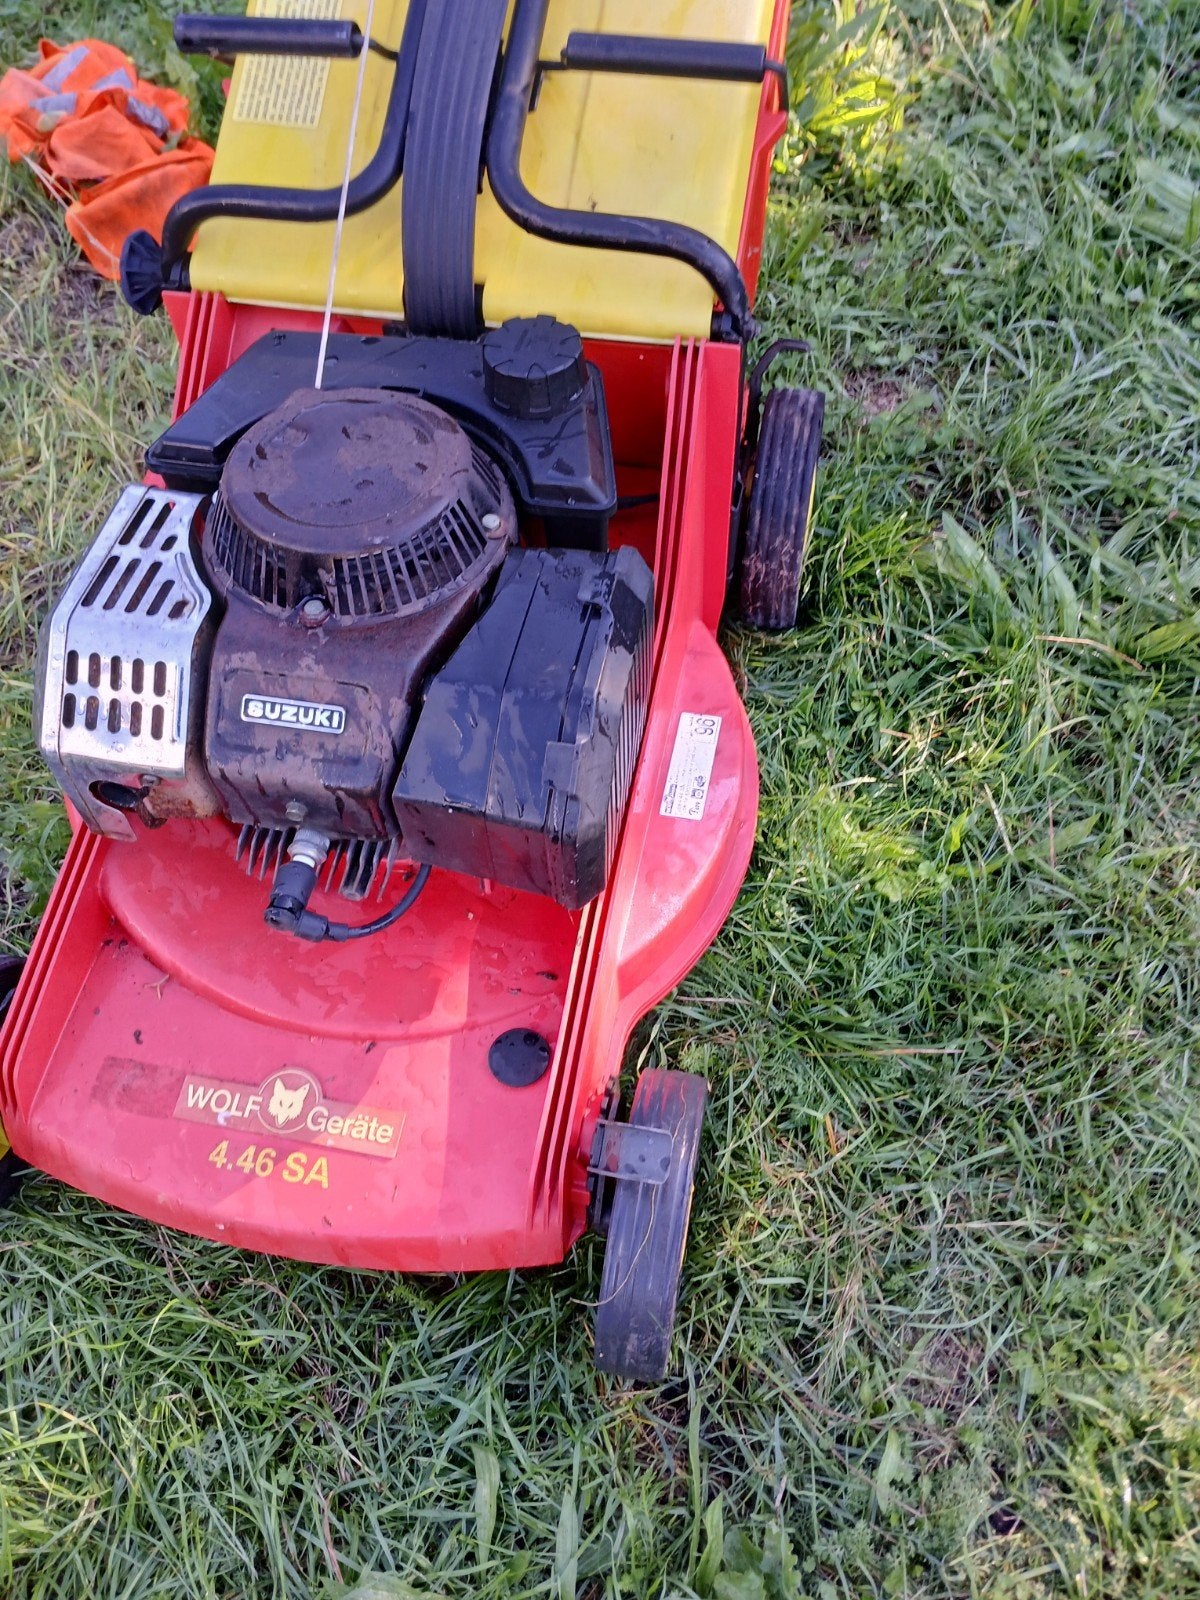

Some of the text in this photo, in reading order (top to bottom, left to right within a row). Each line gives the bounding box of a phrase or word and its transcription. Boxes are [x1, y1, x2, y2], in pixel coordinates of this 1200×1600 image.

[247, 700, 340, 728] SUZUKI
[187, 1084, 394, 1144] WOLF Geräte
[208, 1140, 329, 1189] 4.46 SA
